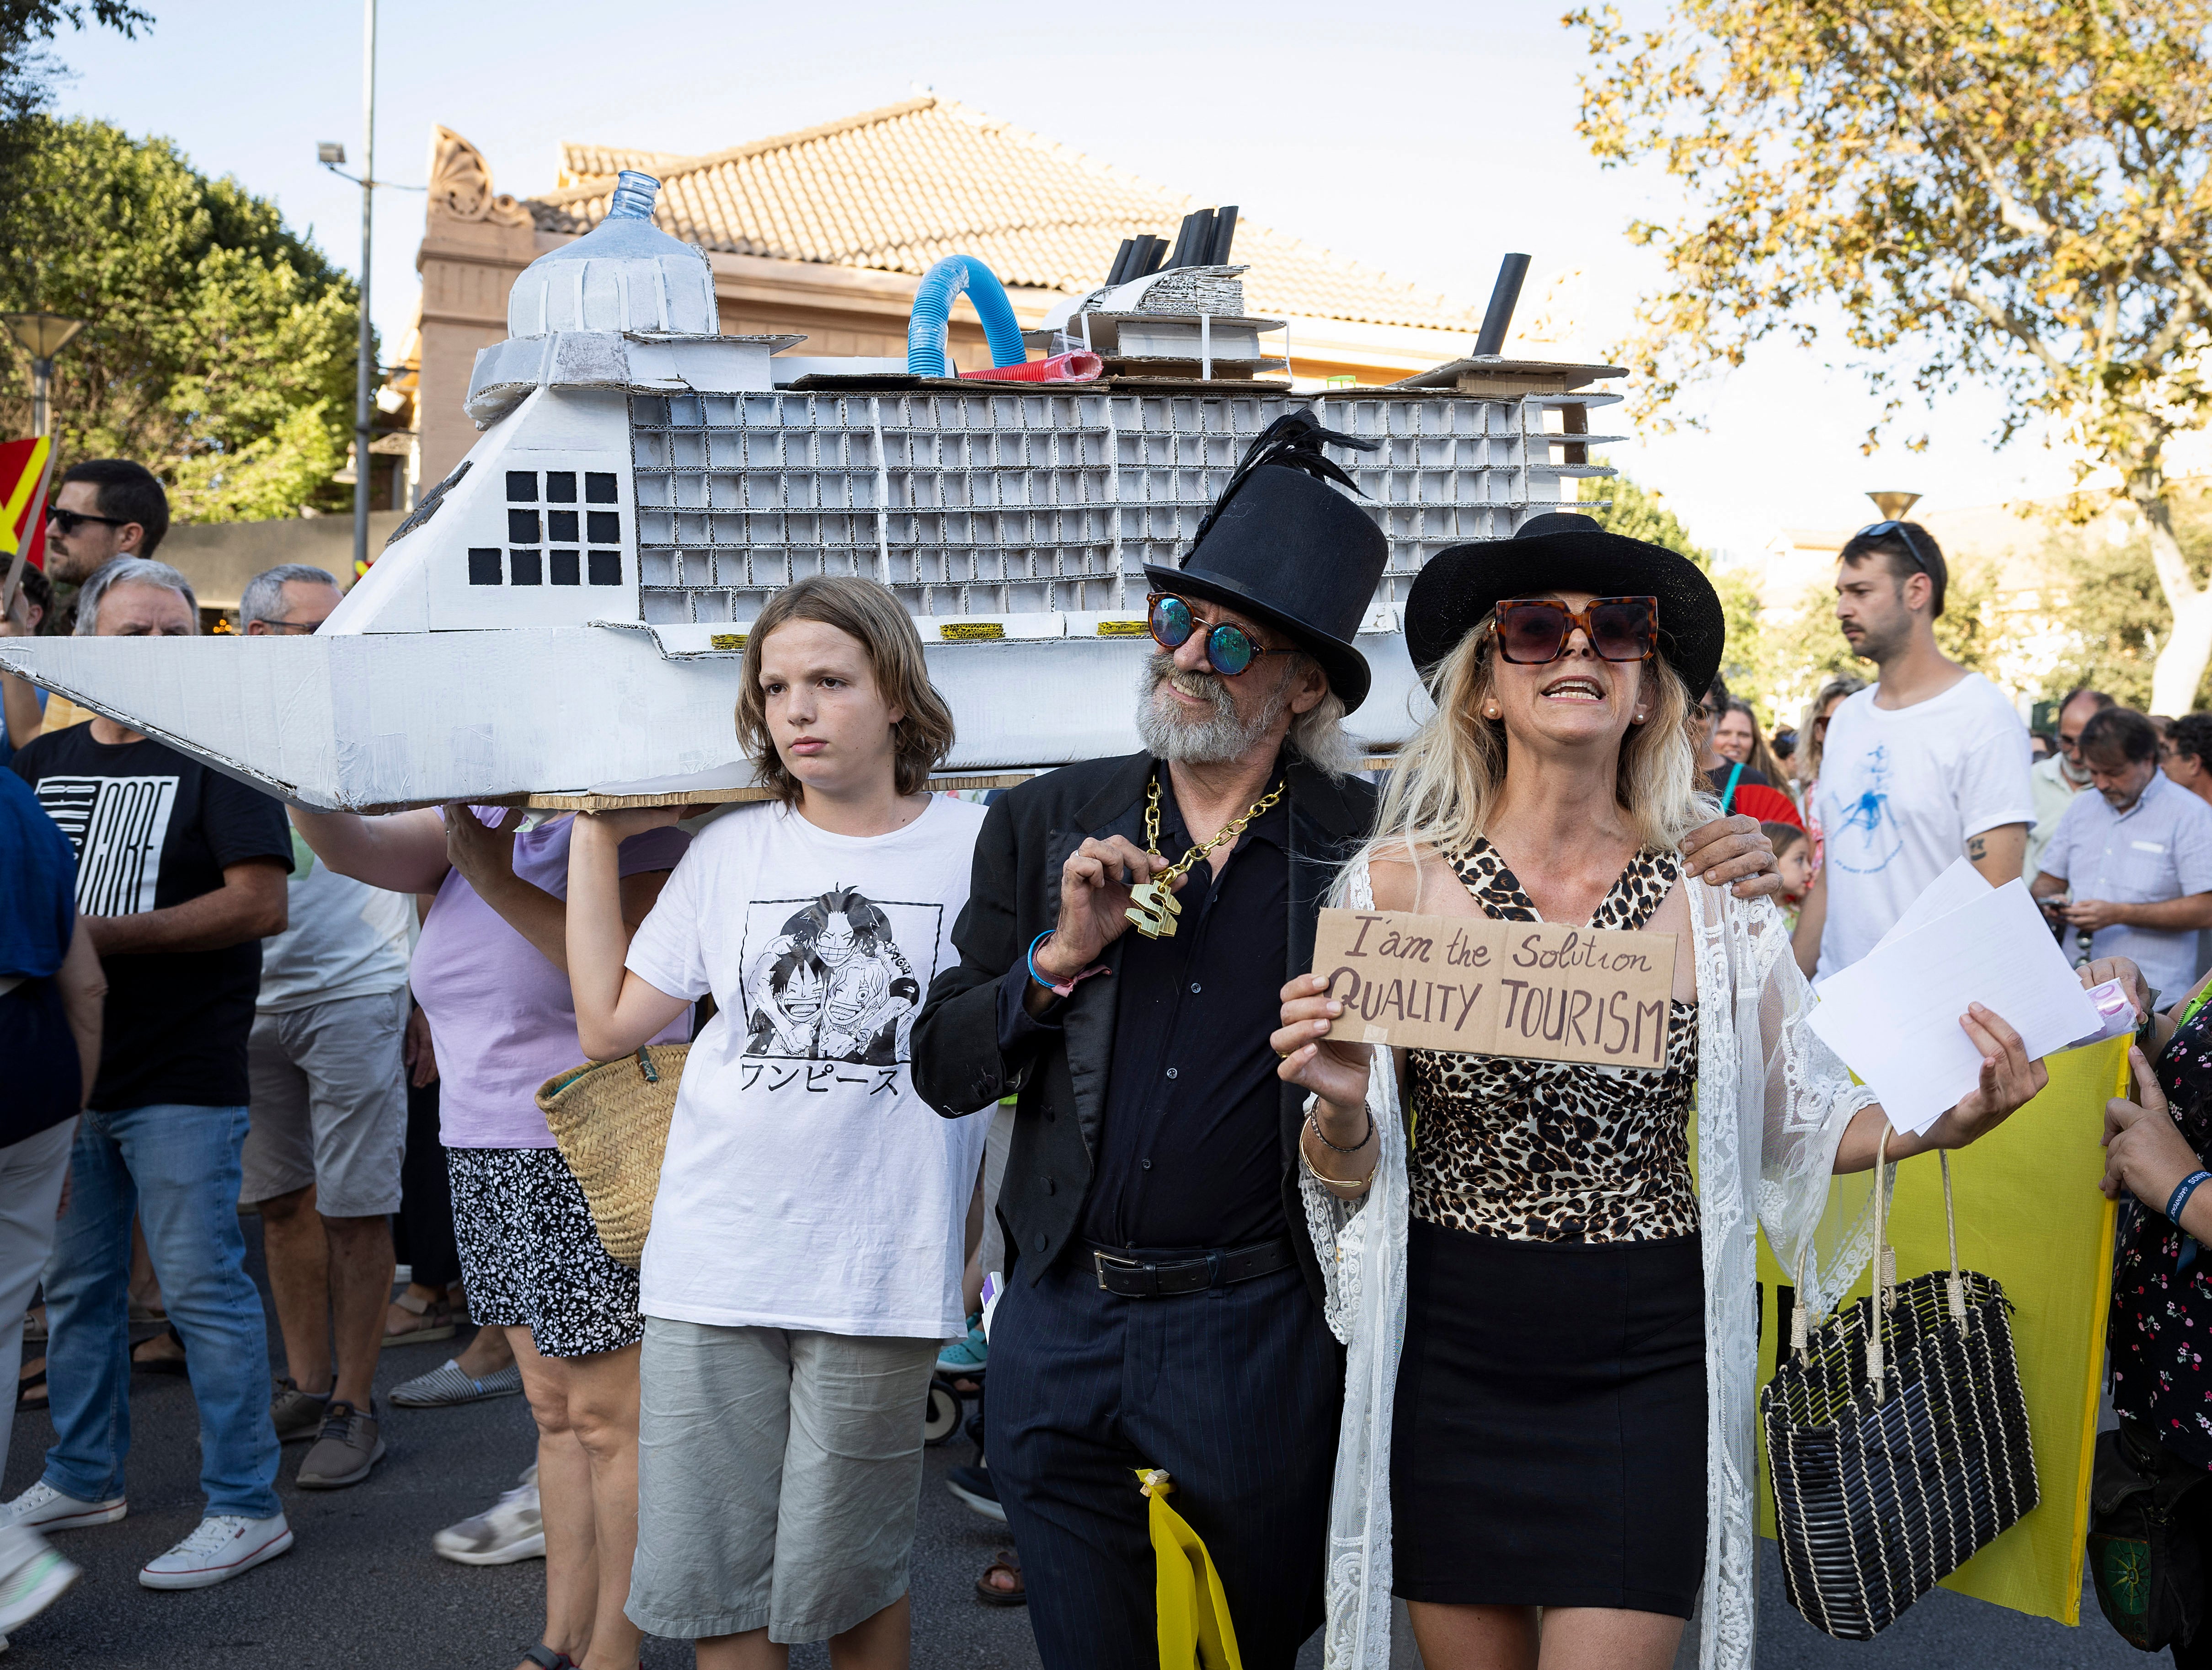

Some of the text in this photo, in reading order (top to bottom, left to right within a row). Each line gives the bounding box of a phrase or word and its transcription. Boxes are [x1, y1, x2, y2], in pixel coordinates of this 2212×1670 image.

[1447, 927, 1491, 968] the
[1512, 931, 1652, 972] Solution
[1324, 966, 1664, 1063] QUALITY TOURISM
[741, 1063, 899, 1097] ワンピース
[2170, 1186, 2188, 1217] GREENPEACE
